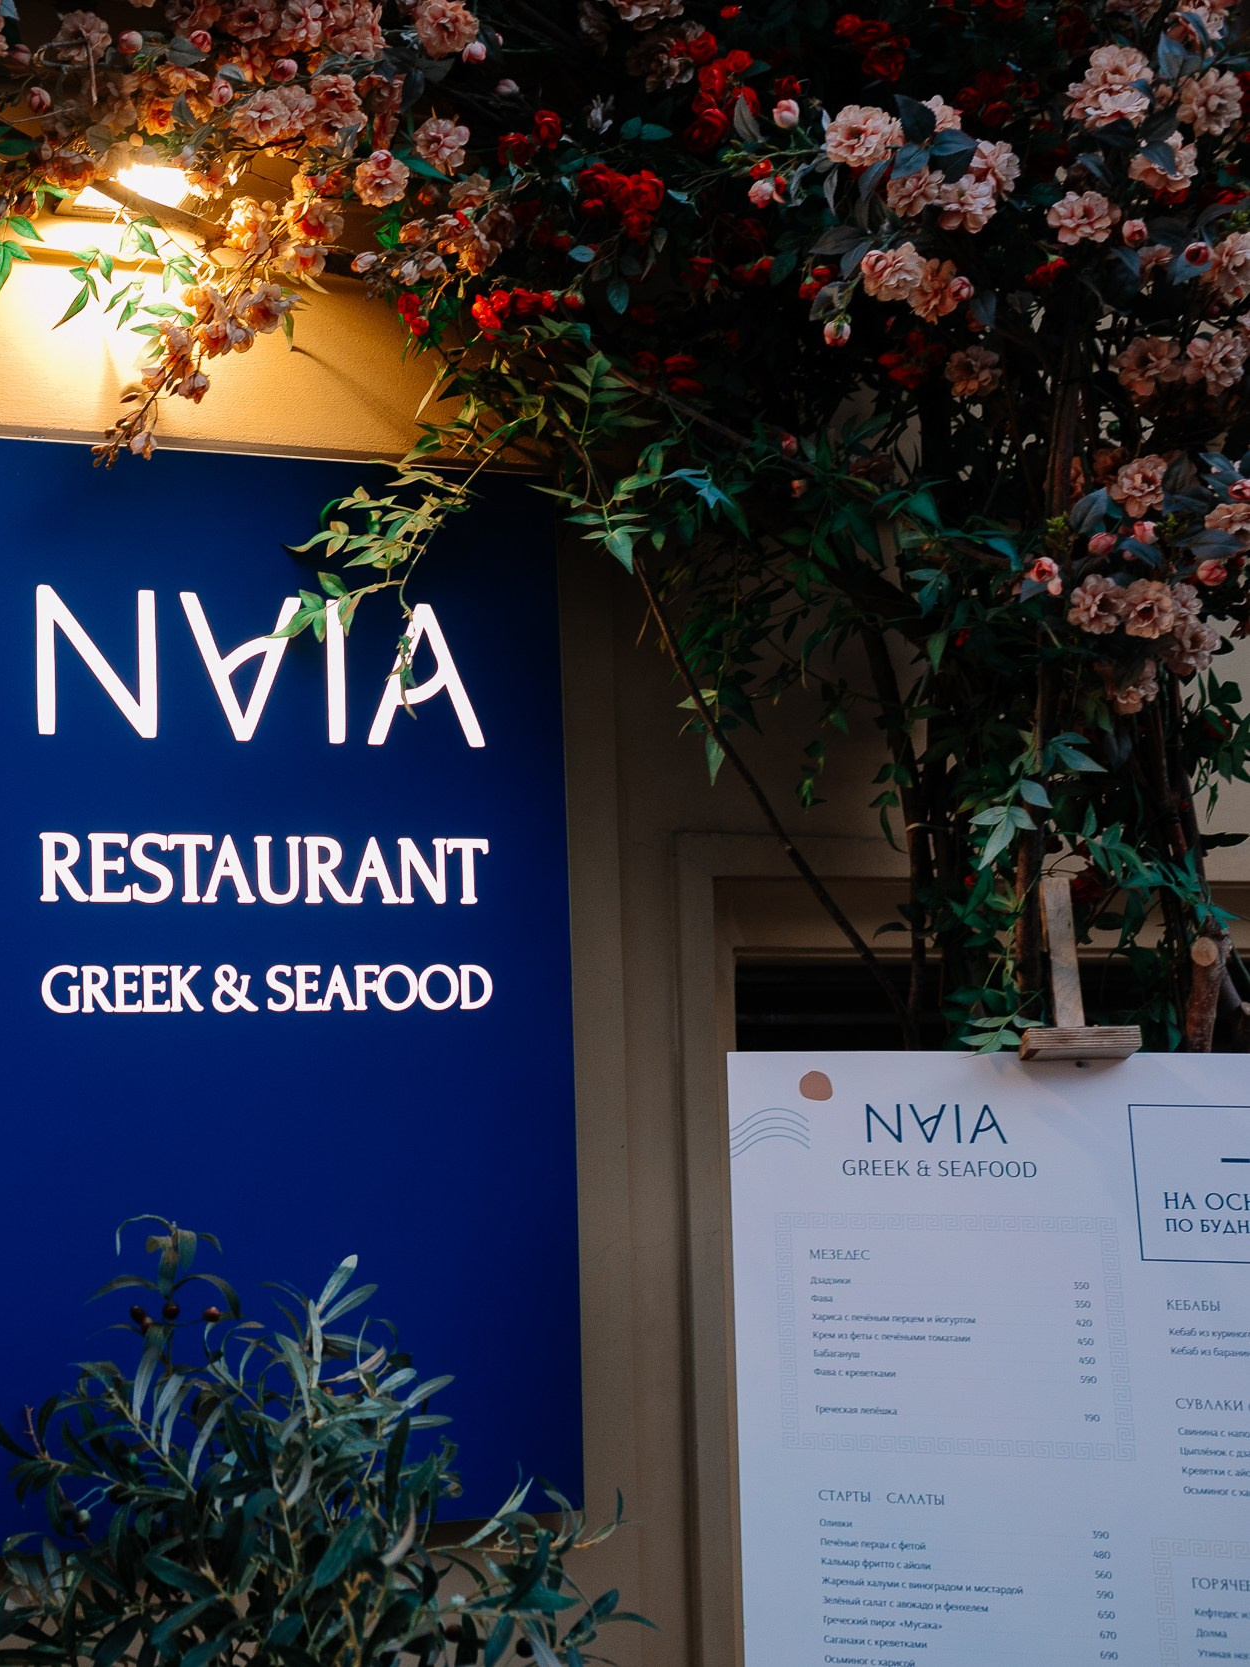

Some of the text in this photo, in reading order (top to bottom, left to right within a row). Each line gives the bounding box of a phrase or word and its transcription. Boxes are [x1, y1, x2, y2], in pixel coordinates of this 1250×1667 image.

[38, 832, 489, 905] RESTAURANT
[41, 964, 493, 1014] GREEK & SEAFOOD
[842, 1159, 1037, 1178] GREEK & SEAFOOD
[1163, 1192, 1197, 1209] НА
[1165, 1218, 1250, 1234] ПО БУДН
[810, 1276, 1090, 1290] Дзадзики 350
[811, 1294, 1091, 1309] Фава 350
[1166, 1299, 1221, 1312] КЕБАБЫ
[811, 1313, 843, 1322] Хариса
[892, 1315, 925, 1323] перцем
[934, 1314, 976, 1326] йогуртом
[1075, 1319, 1093, 1327] 420
[812, 1331, 835, 1341] Крем
[849, 1331, 872, 1341] феты
[1077, 1337, 1094, 1346] 450
[1169, 1327, 1197, 1336] Кебаб
[813, 1349, 1096, 1365] Бабагануш 450
[1171, 1346, 1199, 1355] Кебаб
[813, 1368, 836, 1376] Фава
[845, 1370, 896, 1378] креветками
[1080, 1375, 1097, 1384] 590
[1175, 1397, 1243, 1411] СУВЛАКИ
[815, 1405, 1100, 1422] Греческая лепёшка 190
[1178, 1426, 1218, 1437] Свинина
[1180, 1447, 1227, 1457] Цыплёнок
[1181, 1466, 1225, 1477] Креветки
[818, 1489, 945, 1505] СТАРТЫ САЛАТЫ
[1183, 1485, 1228, 1496] Осьминог
[819, 1518, 1109, 1539] Оливки 390
[861, 1541, 889, 1550] перцы
[899, 1541, 926, 1551] фетой
[1093, 1550, 1111, 1559] 480
[821, 1557, 860, 1568] Кальмар
[862, 1558, 894, 1570] фритто
[903, 1560, 931, 1570] айоли
[1094, 1570, 1112, 1579] 560
[821, 1576, 864, 1587] Жареный
[867, 1580, 899, 1590] халуми
[908, 1582, 963, 1593] виноградом
[974, 1585, 1024, 1596] мостардой
[1096, 1590, 1114, 1599] 590
[823, 1595, 860, 1606] Зелёный
[862, 1598, 887, 1607] салат
[897, 1601, 933, 1610] авокадо
[944, 1601, 989, 1613] фенхелем
[1097, 1610, 1115, 1619] 650
[1194, 1608, 1238, 1620] Кефтедес
[823, 1615, 1117, 1640] Греческий пирог «Мусака» 670
[1196, 1628, 1228, 1638] Долма
[824, 1635, 865, 1646] Саганаки
[874, 1639, 927, 1649] креветками
[1100, 1651, 1118, 1660] 690
[1198, 1648, 1231, 1659] Утиная
[824, 1654, 868, 1665] Осьминог
